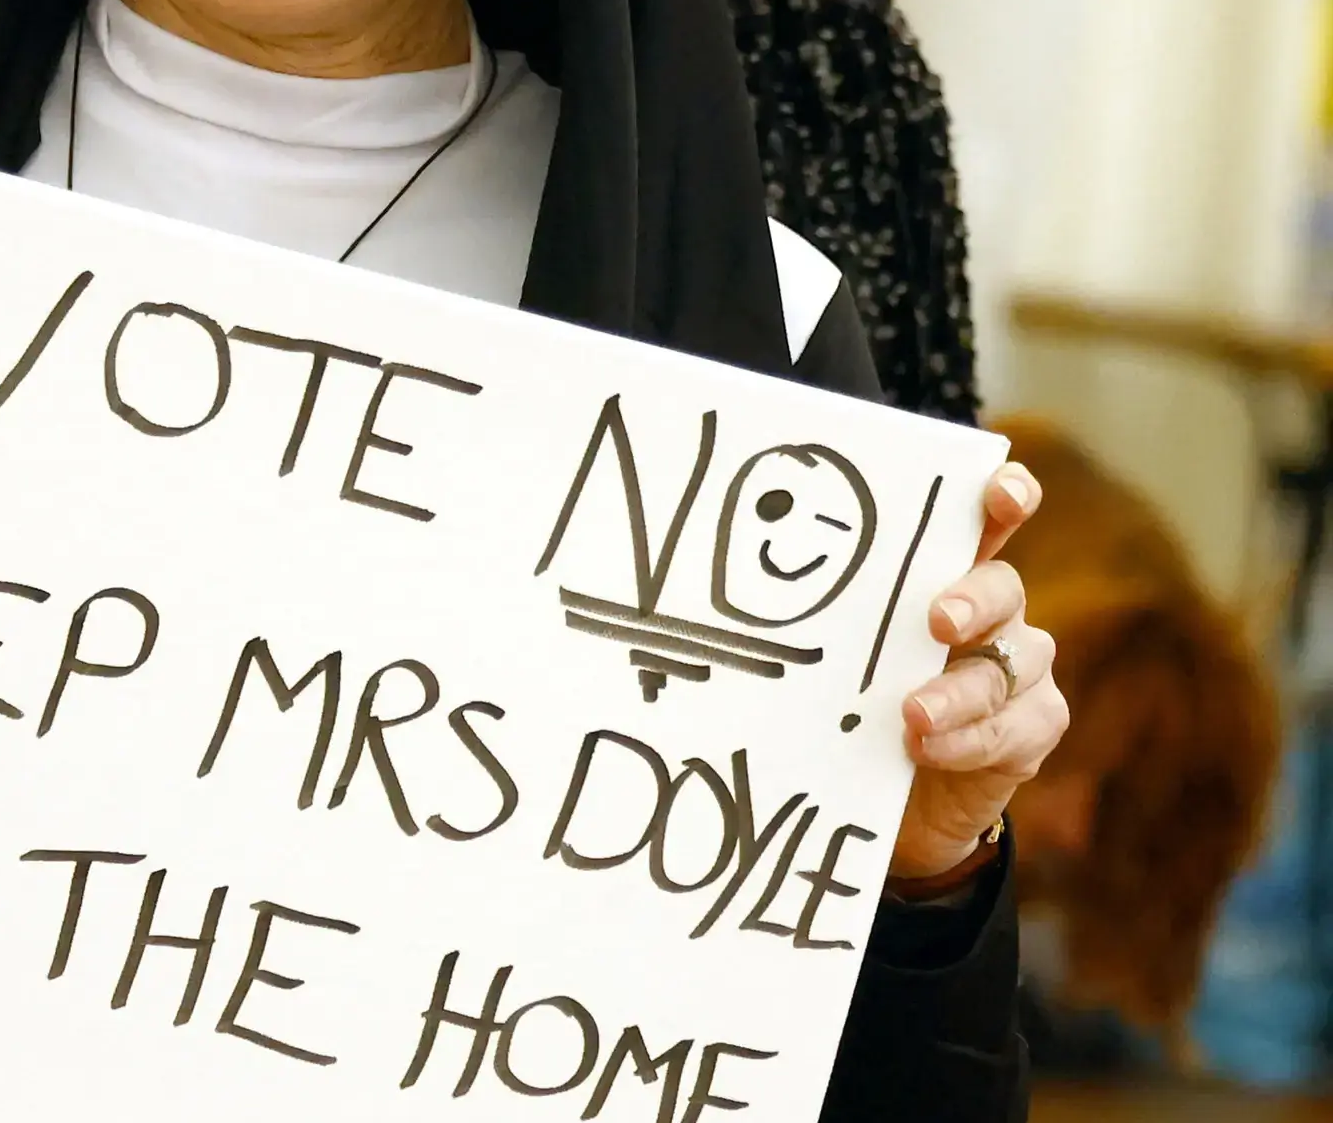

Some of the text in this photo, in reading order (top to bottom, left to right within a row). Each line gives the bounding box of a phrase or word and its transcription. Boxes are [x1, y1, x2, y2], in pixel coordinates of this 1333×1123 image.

[196, 635, 520, 842] MRS
[542, 728, 878, 950] DOYLE
[19, 848, 361, 1066] THE
